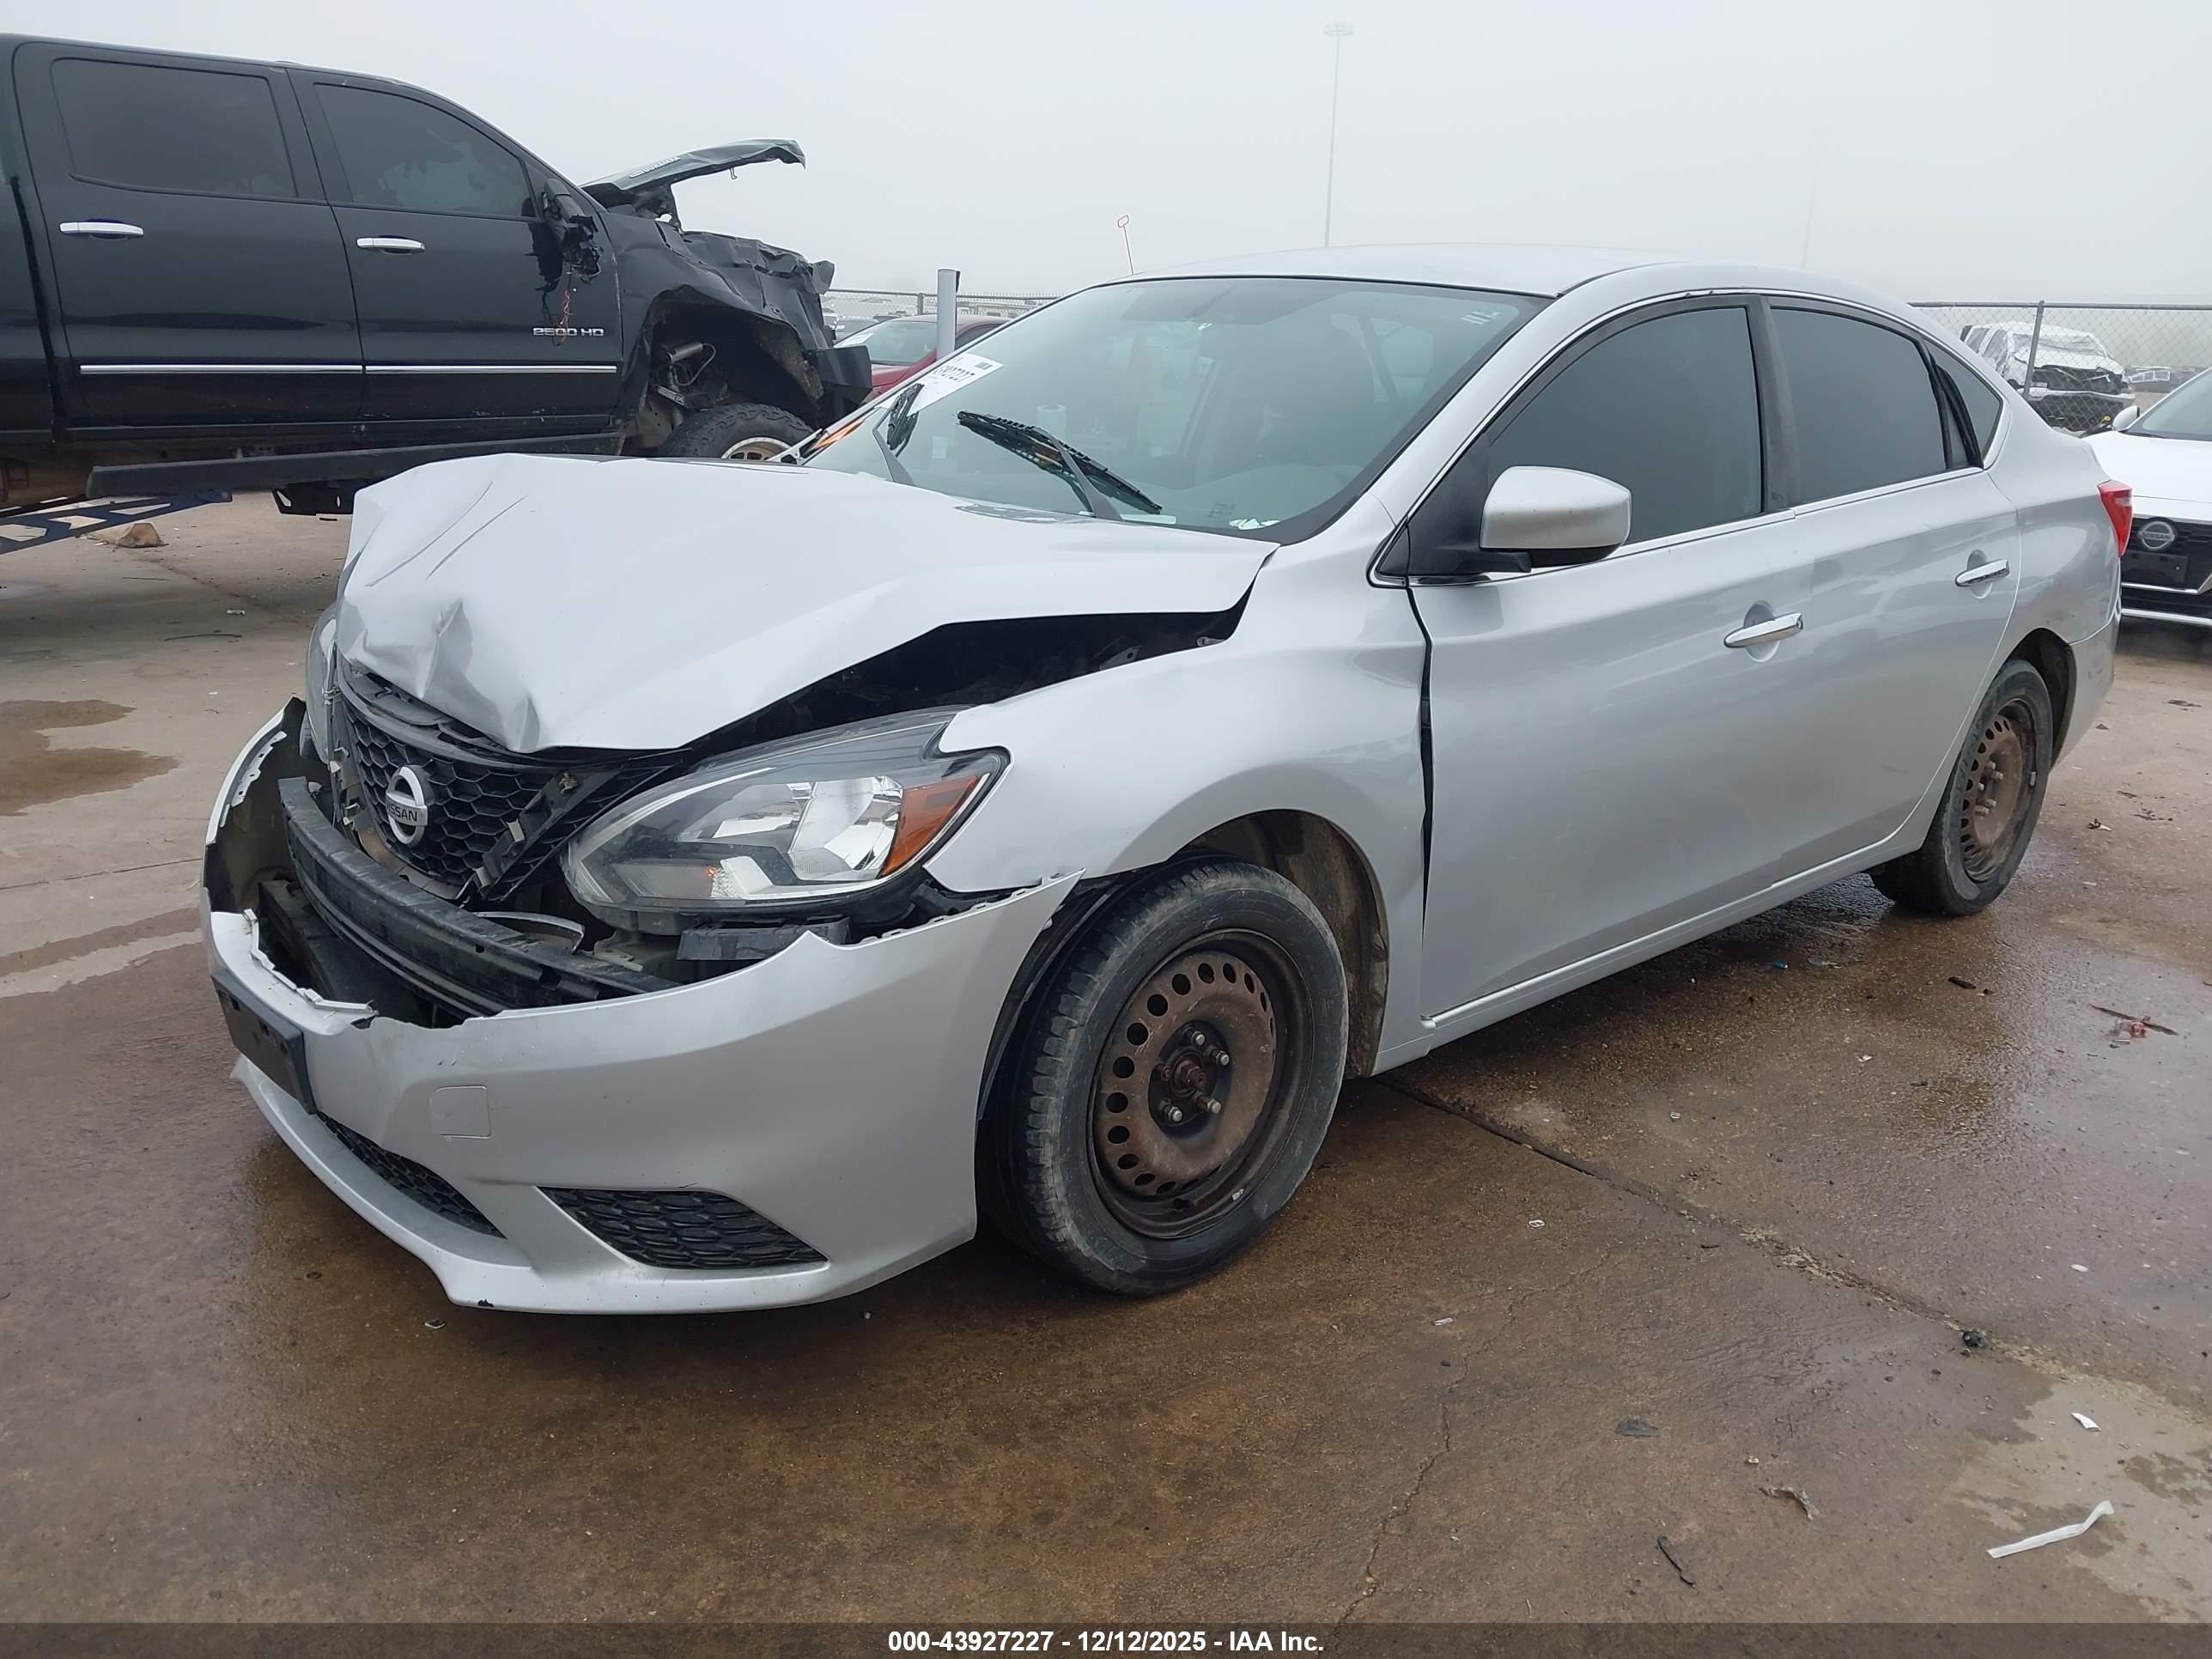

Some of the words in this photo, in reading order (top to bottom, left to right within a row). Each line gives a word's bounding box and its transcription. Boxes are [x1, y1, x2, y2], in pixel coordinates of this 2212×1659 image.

[532, 327, 577, 337] 2500
[580, 328, 604, 337] HD
[2142, 532, 2171, 541] NISSAN
